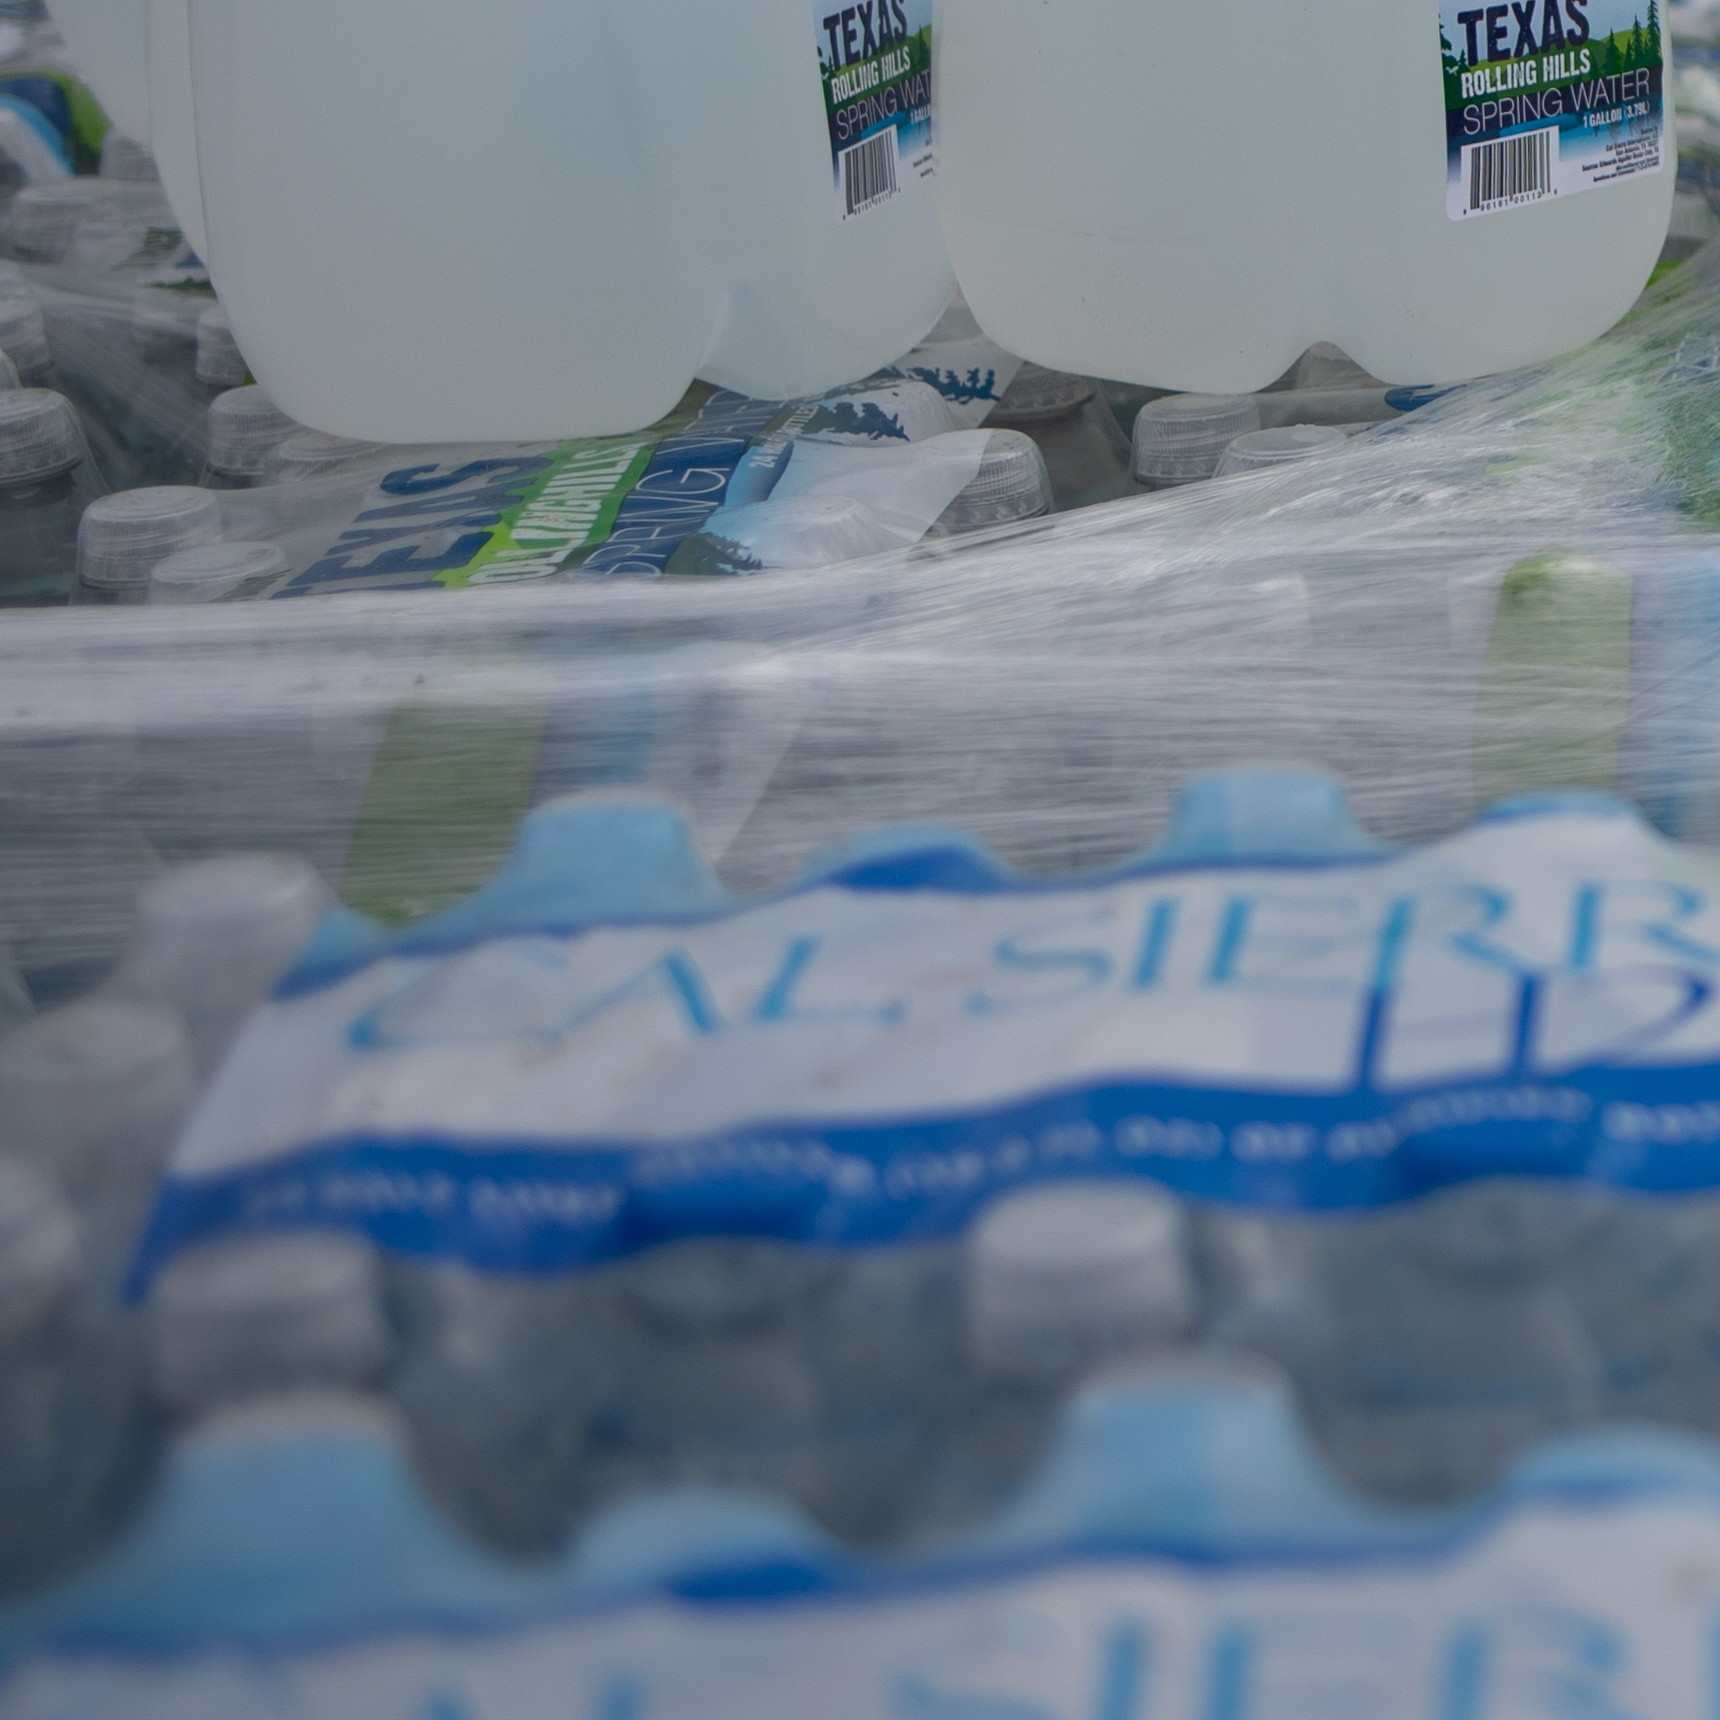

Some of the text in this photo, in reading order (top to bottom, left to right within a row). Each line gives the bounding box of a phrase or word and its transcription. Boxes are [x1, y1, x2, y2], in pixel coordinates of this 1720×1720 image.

[831, 46, 911, 104] ROLLING HILLS
[1461, 48, 1591, 99] ROLLING HILLS
[1463, 67, 1650, 135] SPRING WATER
[836, 68, 931, 140] SPRING WAT
[1590, 107, 1623, 127] GALLON
